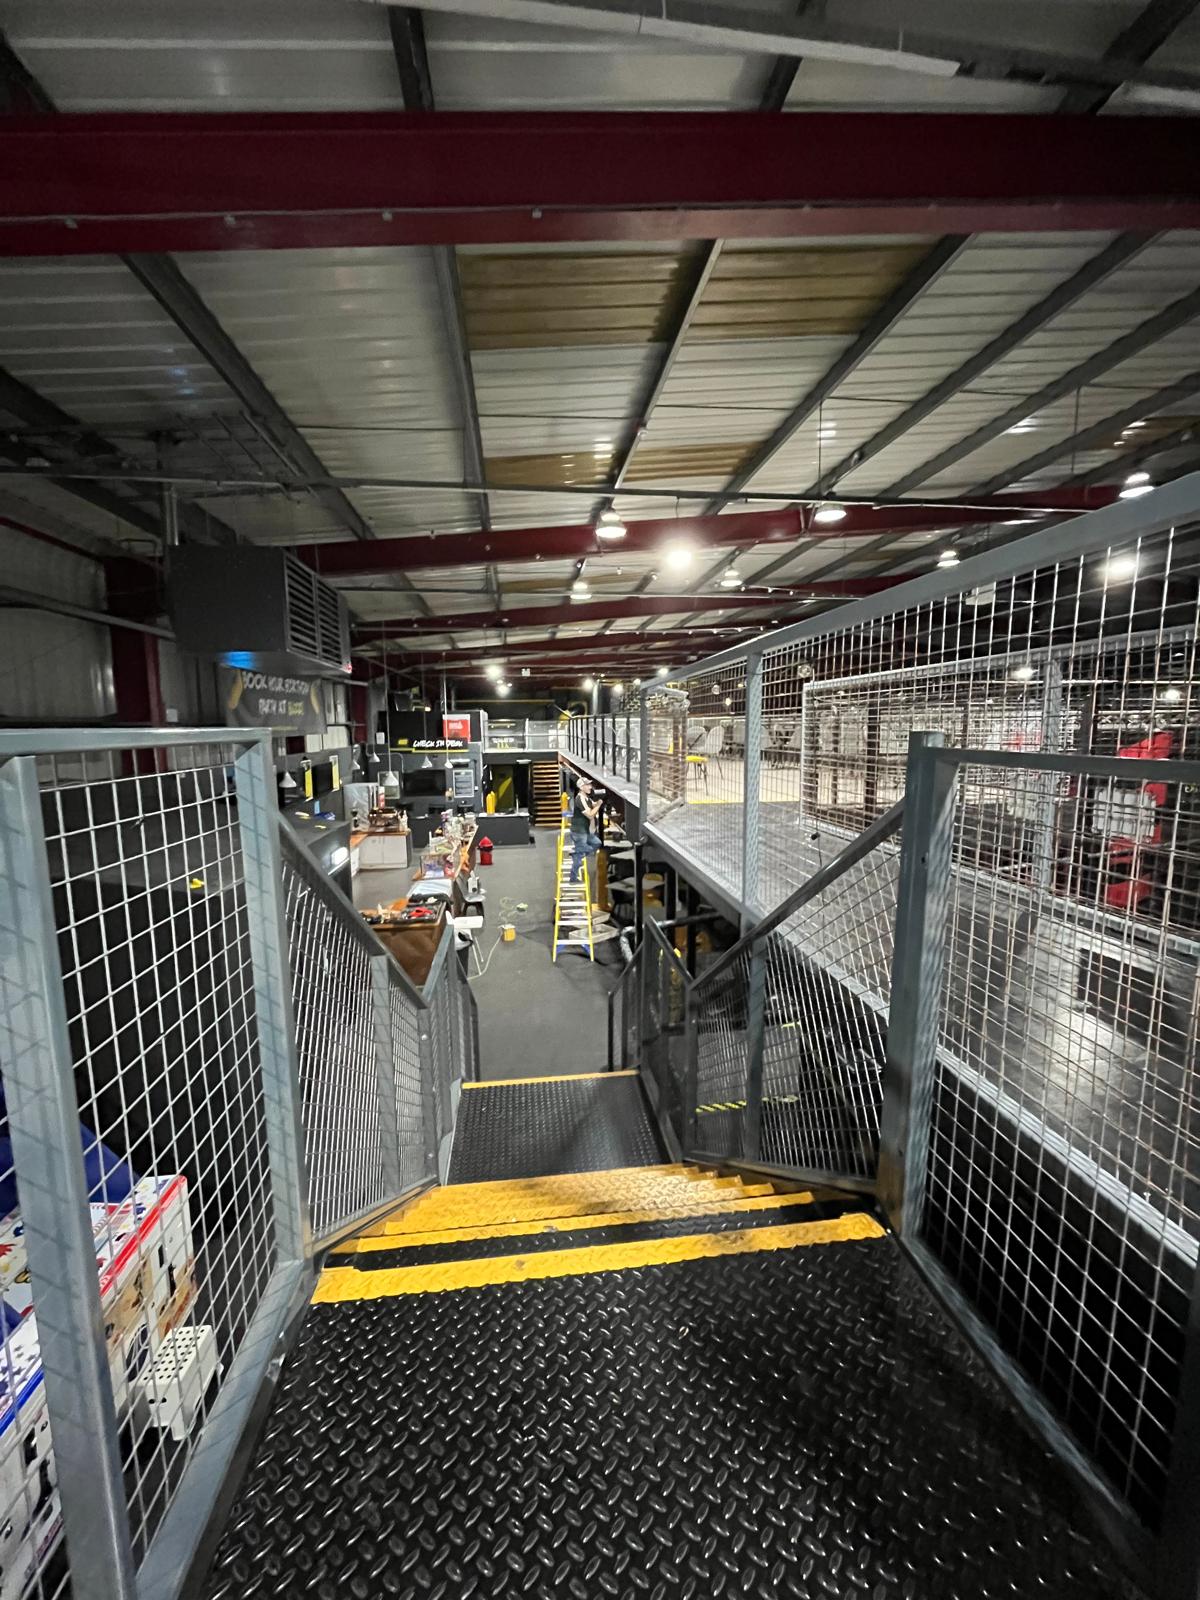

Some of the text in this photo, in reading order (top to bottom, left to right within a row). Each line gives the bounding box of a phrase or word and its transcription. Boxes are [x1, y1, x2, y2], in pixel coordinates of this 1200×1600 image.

[413, 739, 435, 748] CHECK
[435, 739, 445, 748] IN
[446, 739, 464, 748] DESK
